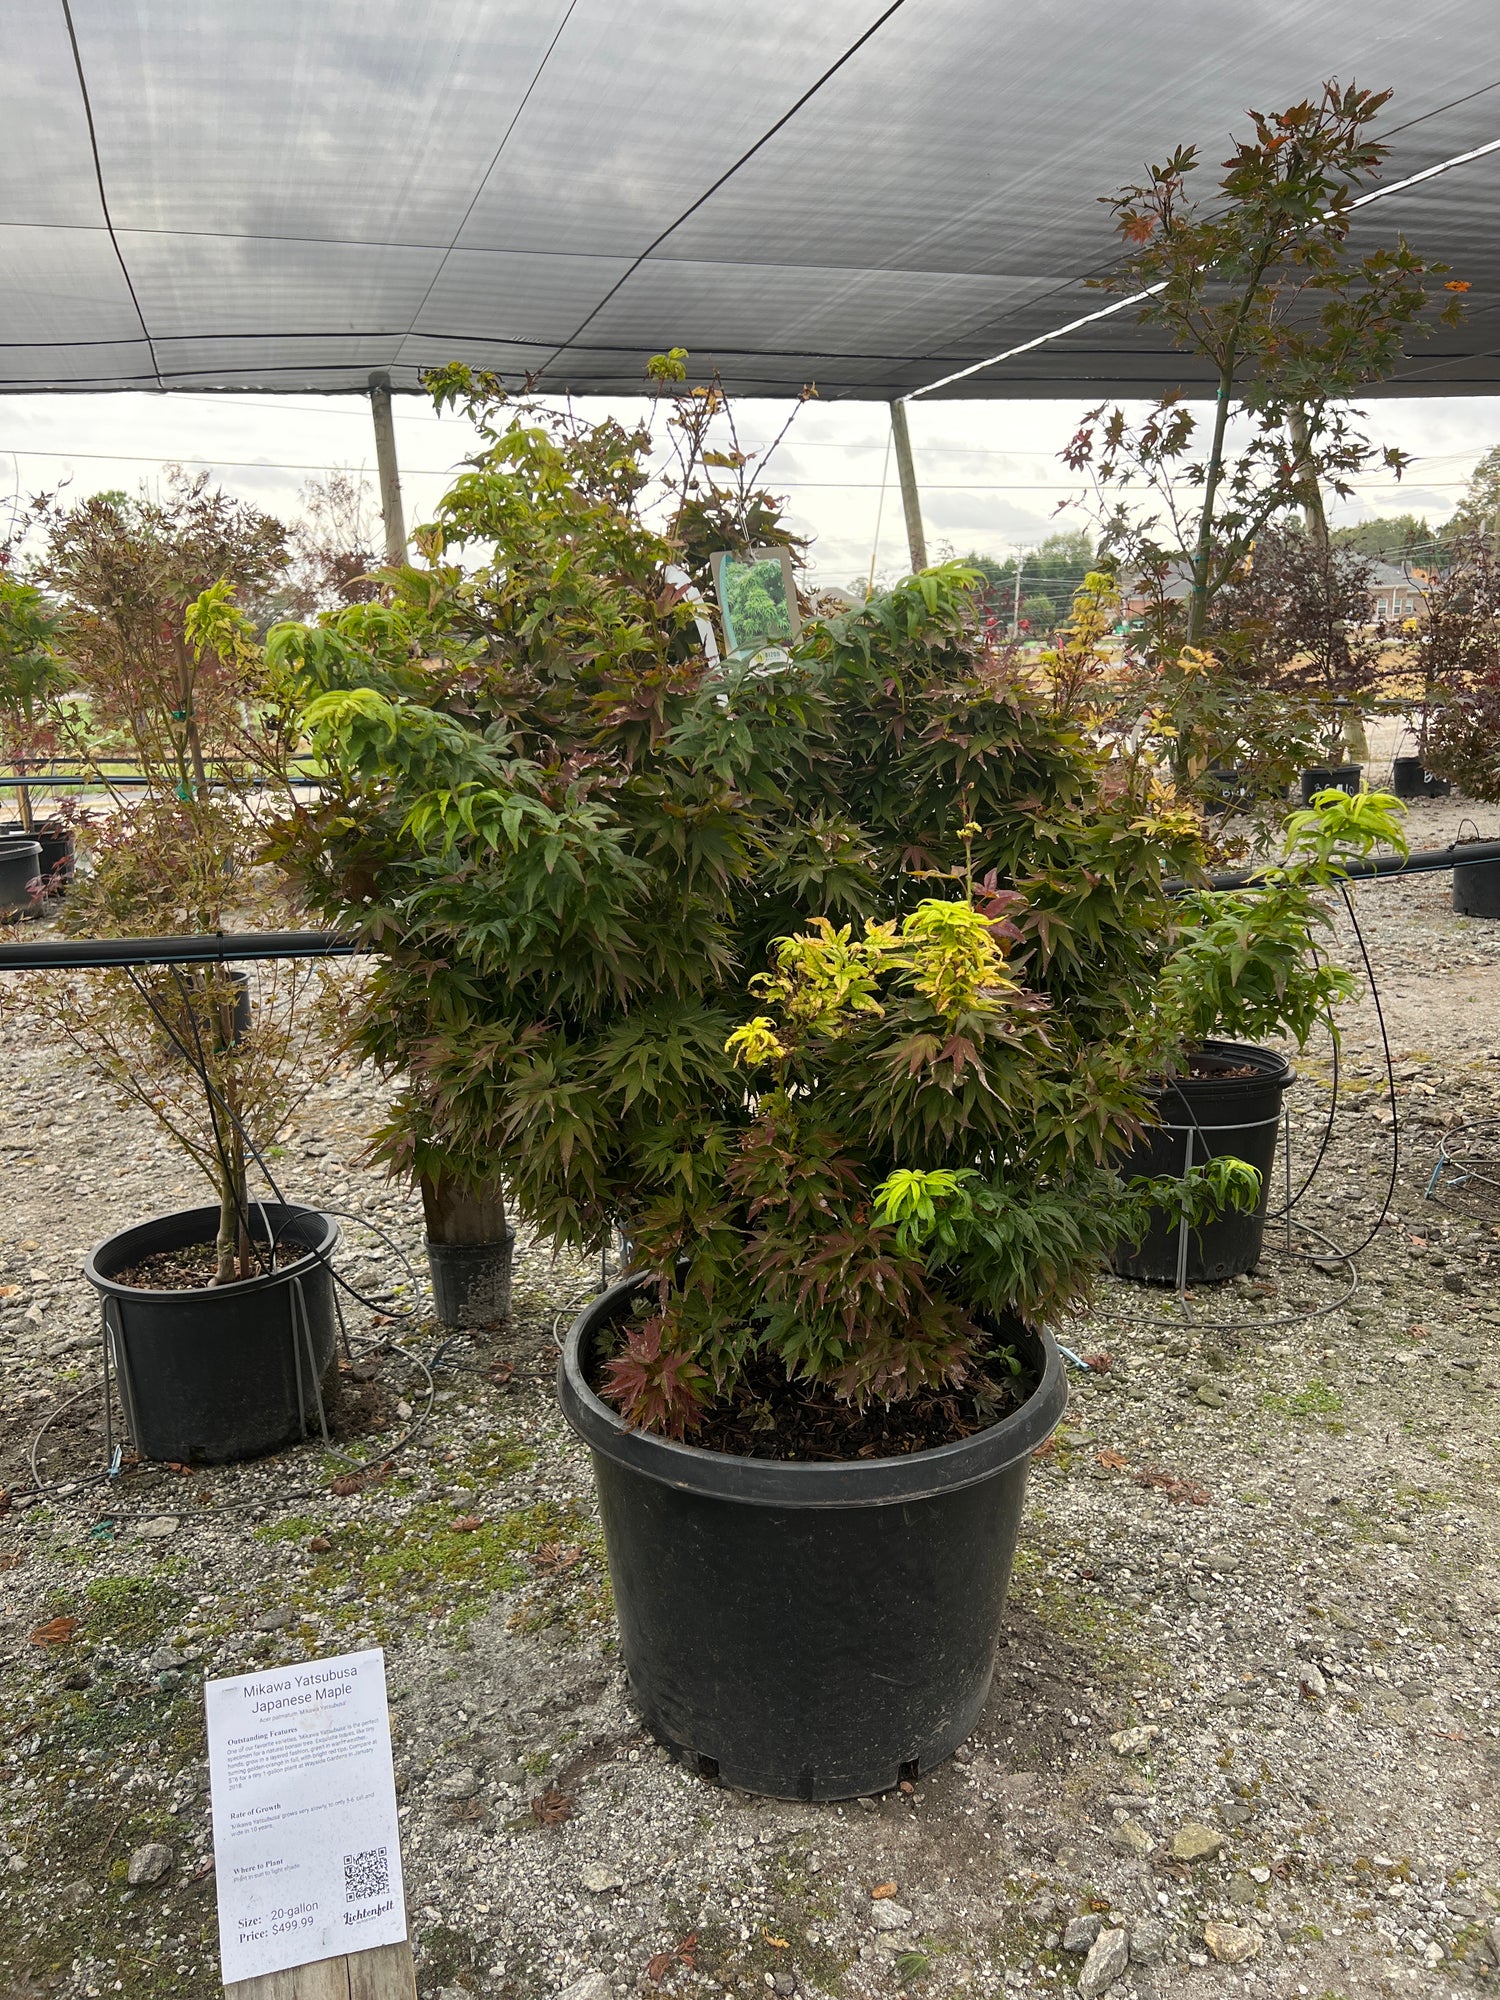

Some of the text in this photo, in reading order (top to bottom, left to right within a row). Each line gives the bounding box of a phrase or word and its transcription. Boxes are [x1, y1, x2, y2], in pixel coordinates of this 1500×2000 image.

[244, 1667, 357, 1698] Mikawa Yatsubusa
[252, 1683, 352, 1713] Japanese Maple
[361, 1718, 379, 1727] perfect
[227, 1728, 298, 1746] Outstanding Features
[227, 1753, 252, 1762] specimen
[247, 1761, 284, 1773] golden-orange
[349, 1741, 371, 1750] Compare
[270, 1752, 288, 1760] layered
[304, 1759, 326, 1767] Wayside
[255, 1803, 281, 1814] Growth
[282, 1811, 298, 1819] grows
[233, 1866, 256, 1874] Where
[266, 1859, 283, 1868] Plant
[238, 1901, 318, 1929] Size: 20-gallon
[343, 1900, 395, 1925] Lichtenfelt
[240, 1916, 314, 1943] Price: $499.99
